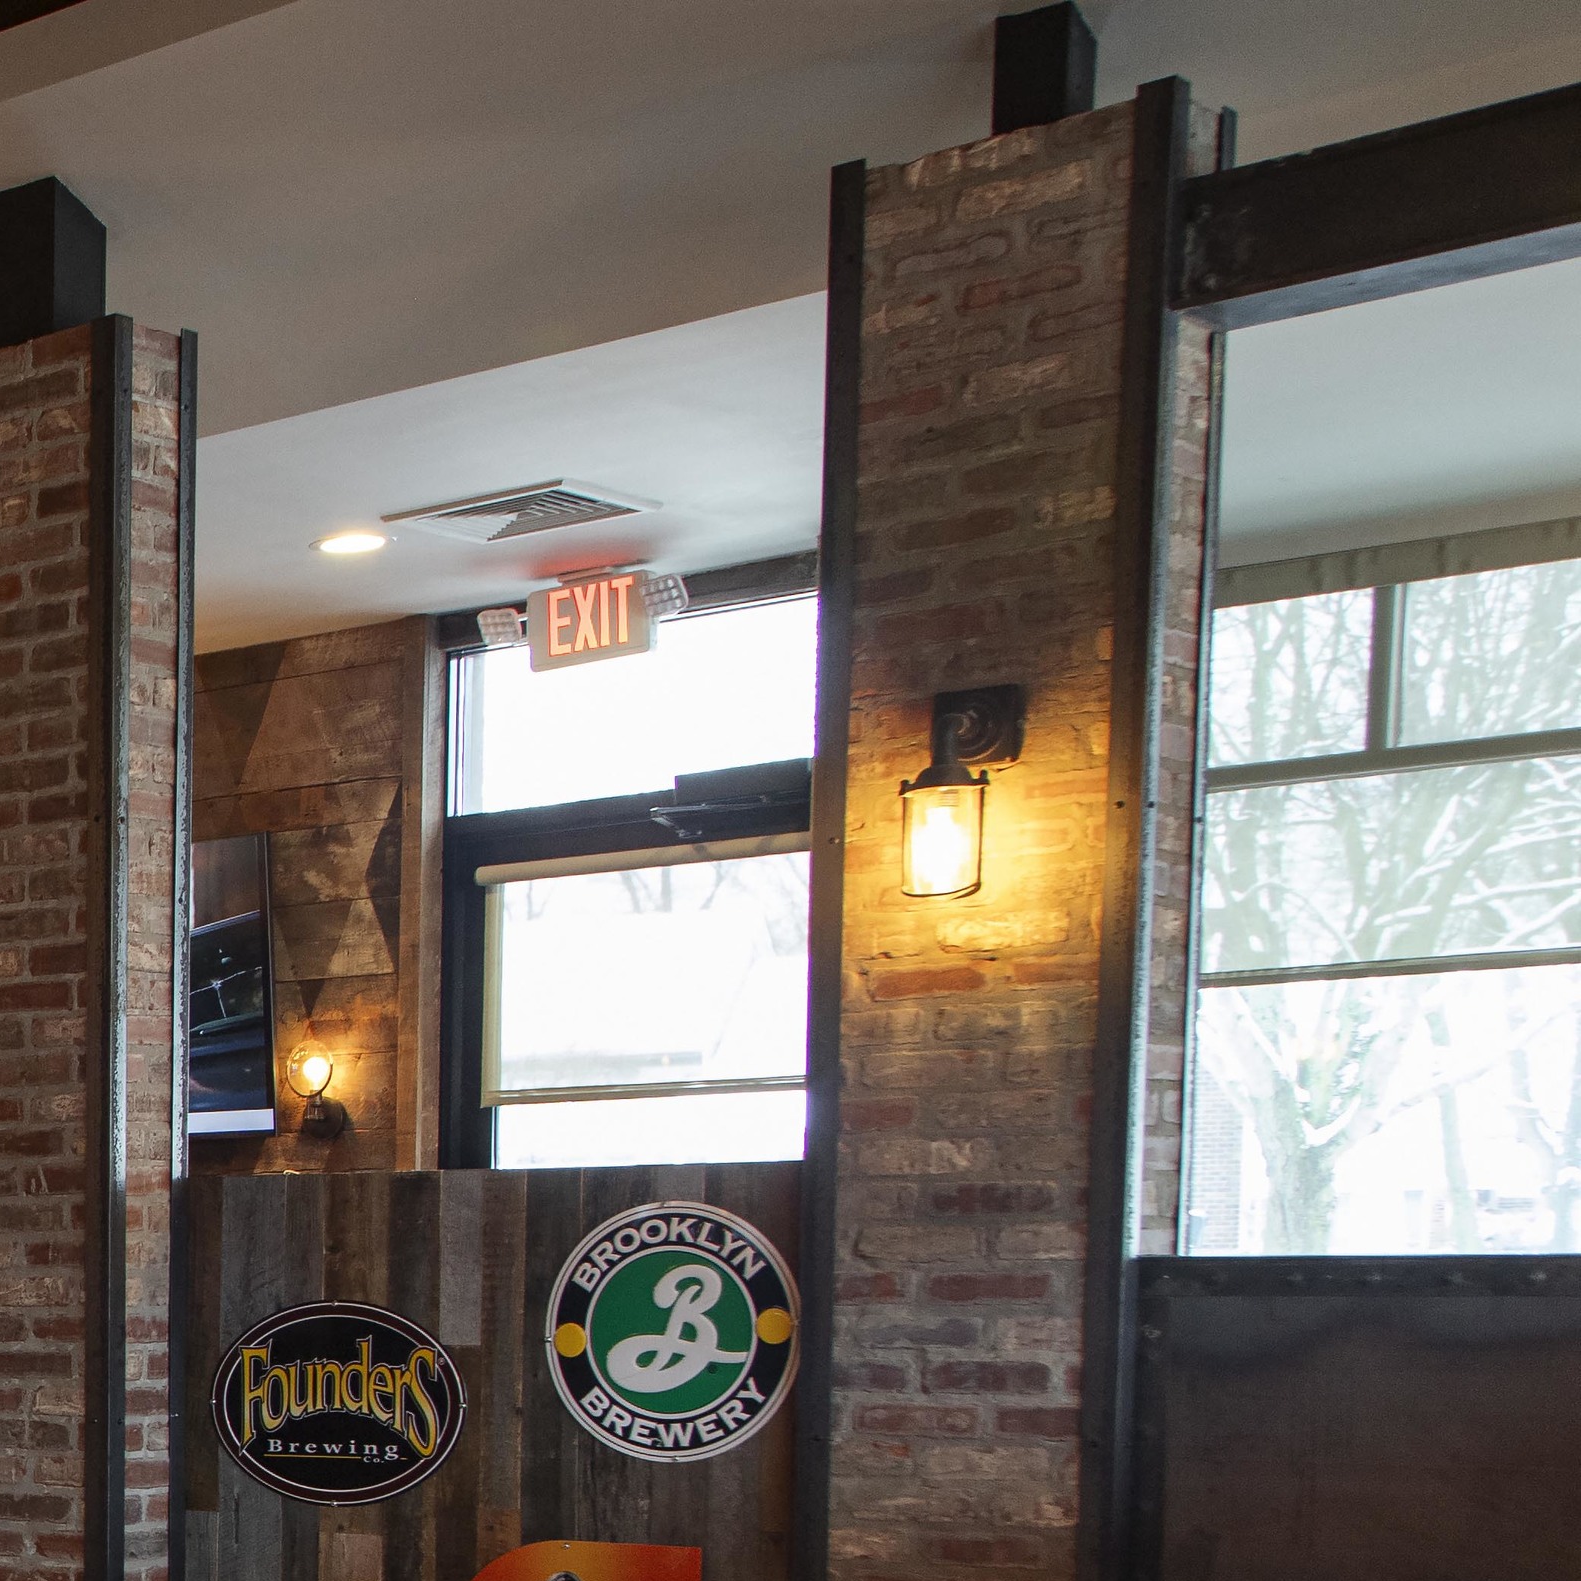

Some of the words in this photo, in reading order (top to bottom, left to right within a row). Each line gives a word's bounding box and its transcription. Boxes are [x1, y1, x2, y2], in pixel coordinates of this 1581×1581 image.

[547, 575, 634, 656] EXIT
[571, 1217, 767, 1293] BROOKLYN
[579, 1377, 767, 1448] BREWERY
[267, 1439, 400, 1460] Brewing
